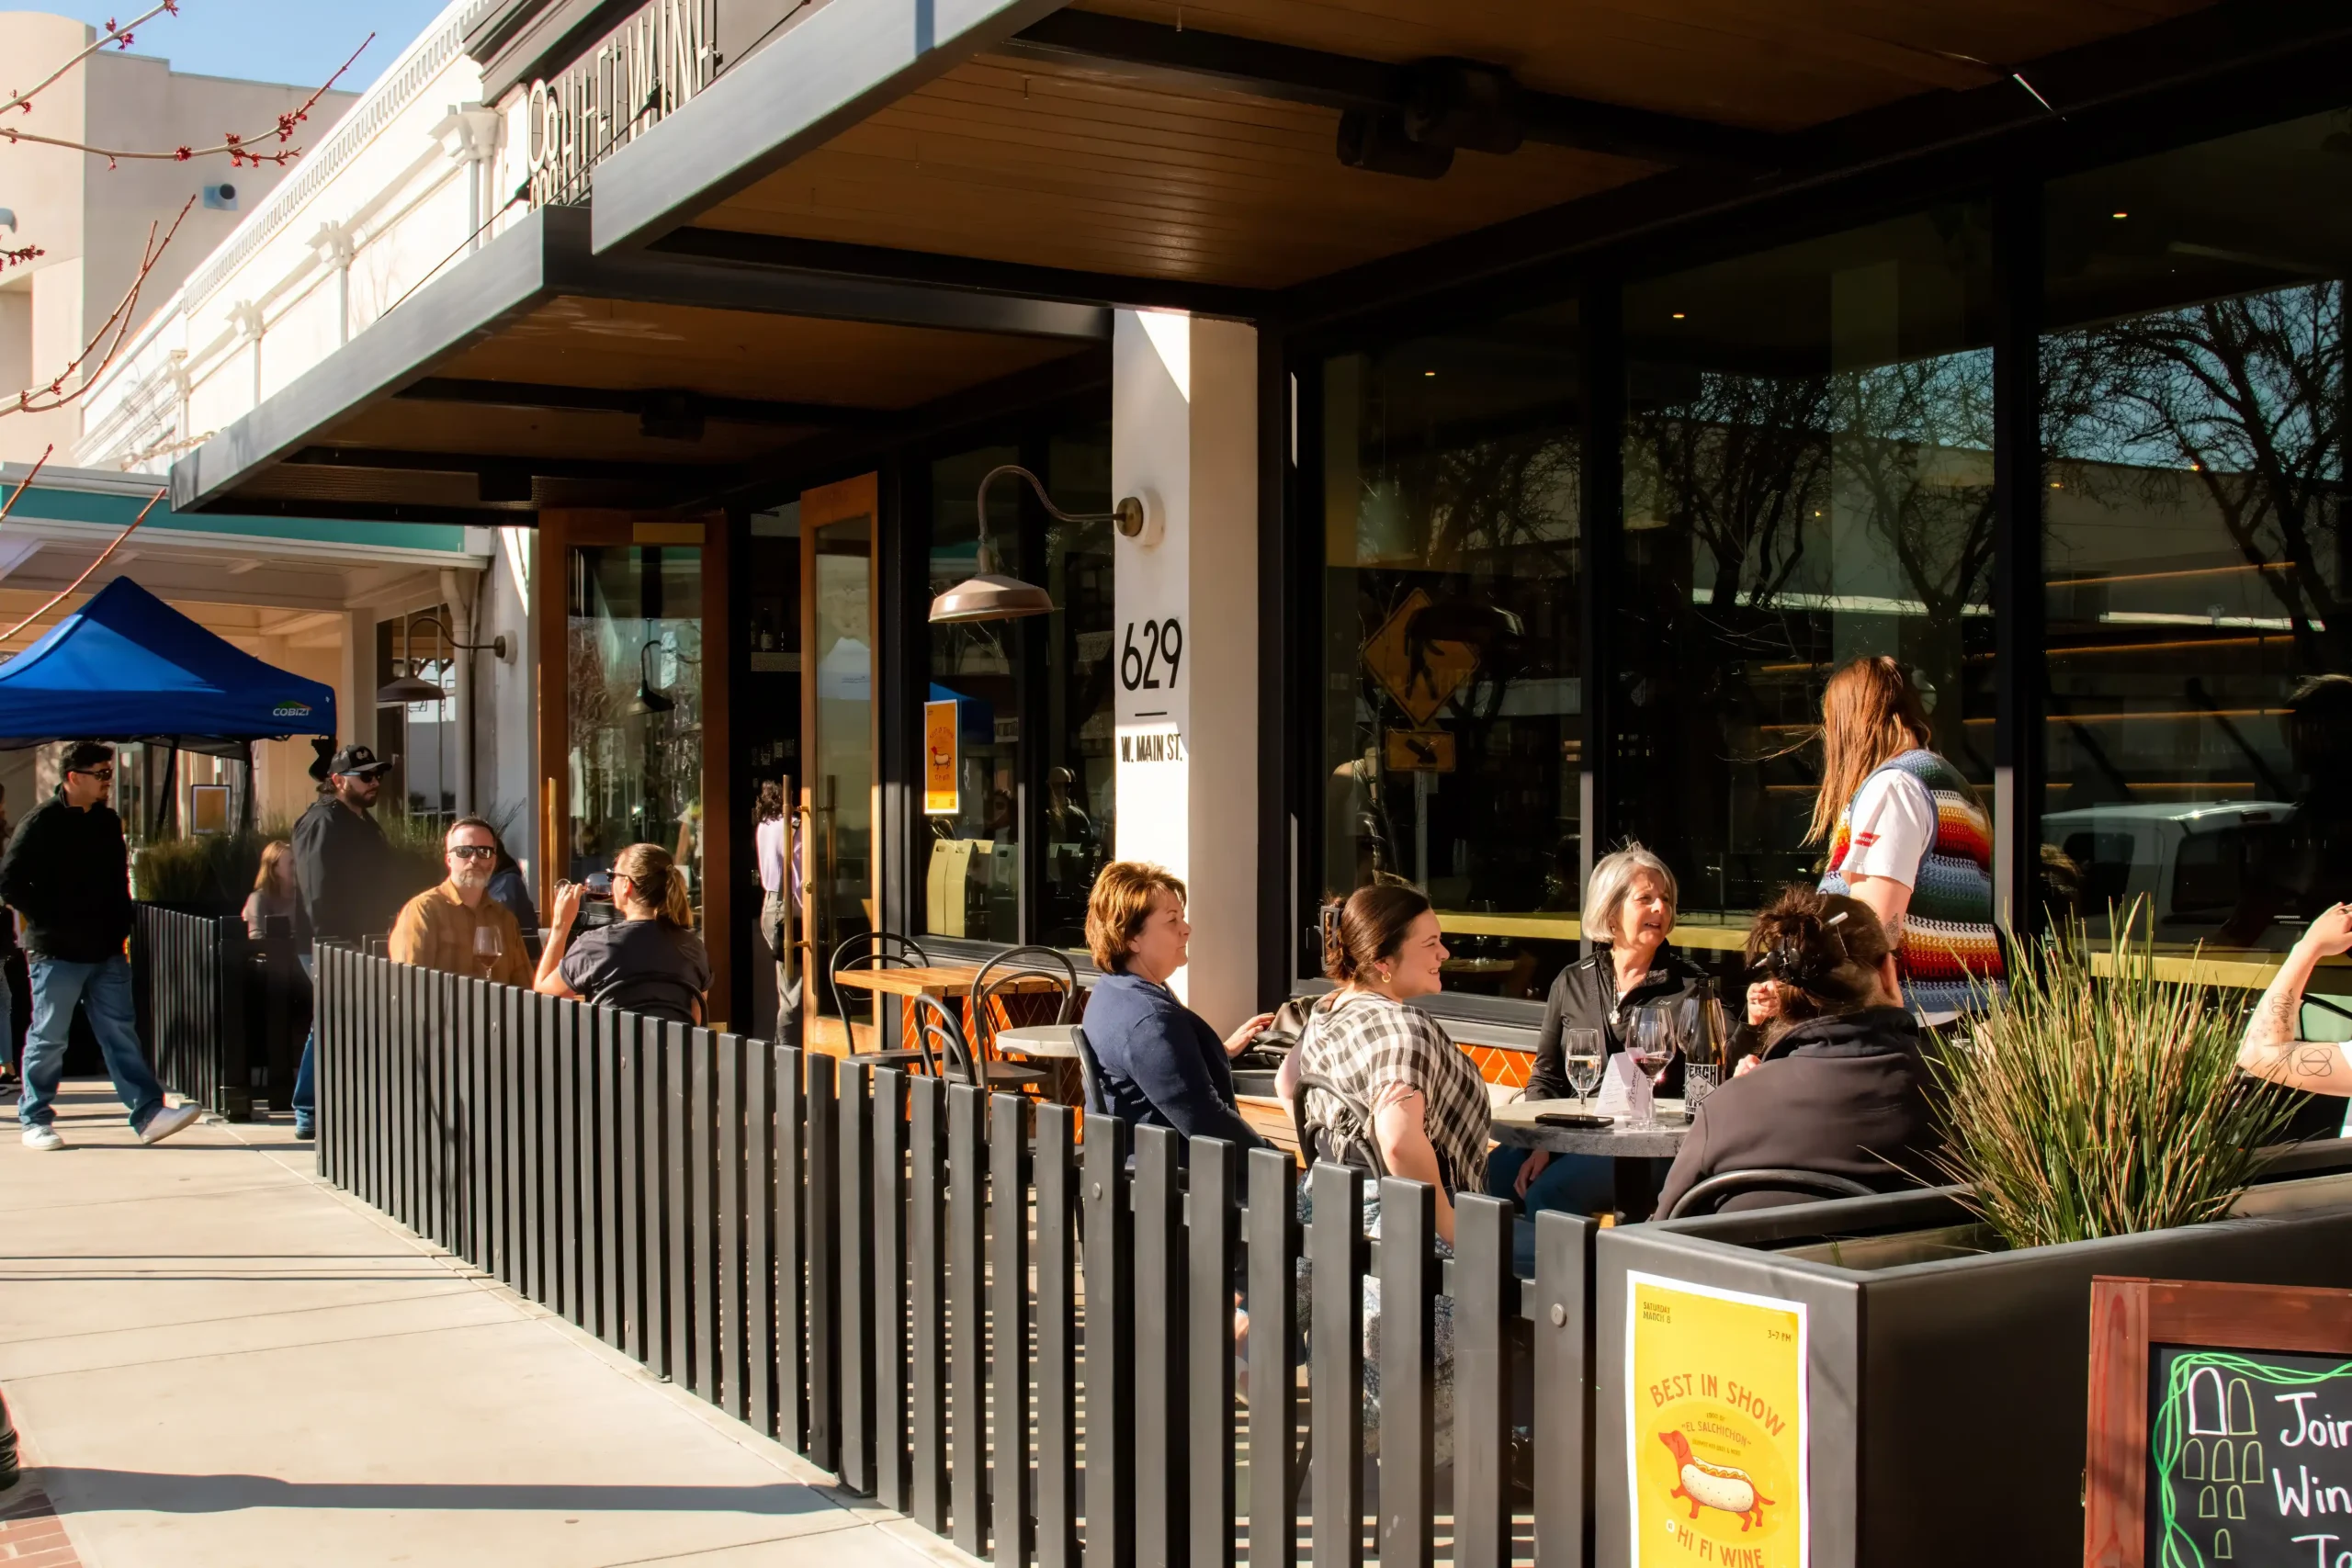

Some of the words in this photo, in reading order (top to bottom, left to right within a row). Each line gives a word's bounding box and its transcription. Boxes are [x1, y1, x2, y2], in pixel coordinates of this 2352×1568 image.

[1121, 618, 1182, 691] 629
[273, 707, 310, 716] COBIZI
[1121, 736, 1134, 762] W.
[1136, 734, 1164, 762] MAIN
[1167, 732, 1182, 761] ST.
[1643, 1302, 1670, 1314] SATURDAY
[1643, 1311, 1665, 1323] MARCH
[1667, 1315, 1671, 1324] 8
[1781, 1332, 1792, 1342] PM
[1649, 1373, 1692, 1408] BEST
[1701, 1373, 1718, 1398] IN
[1726, 1381, 1786, 1437] SHOW
[1677, 1525, 1693, 1551] HI
[1700, 1538, 1713, 1562] FI
[1719, 1545, 1765, 1568] WINE
